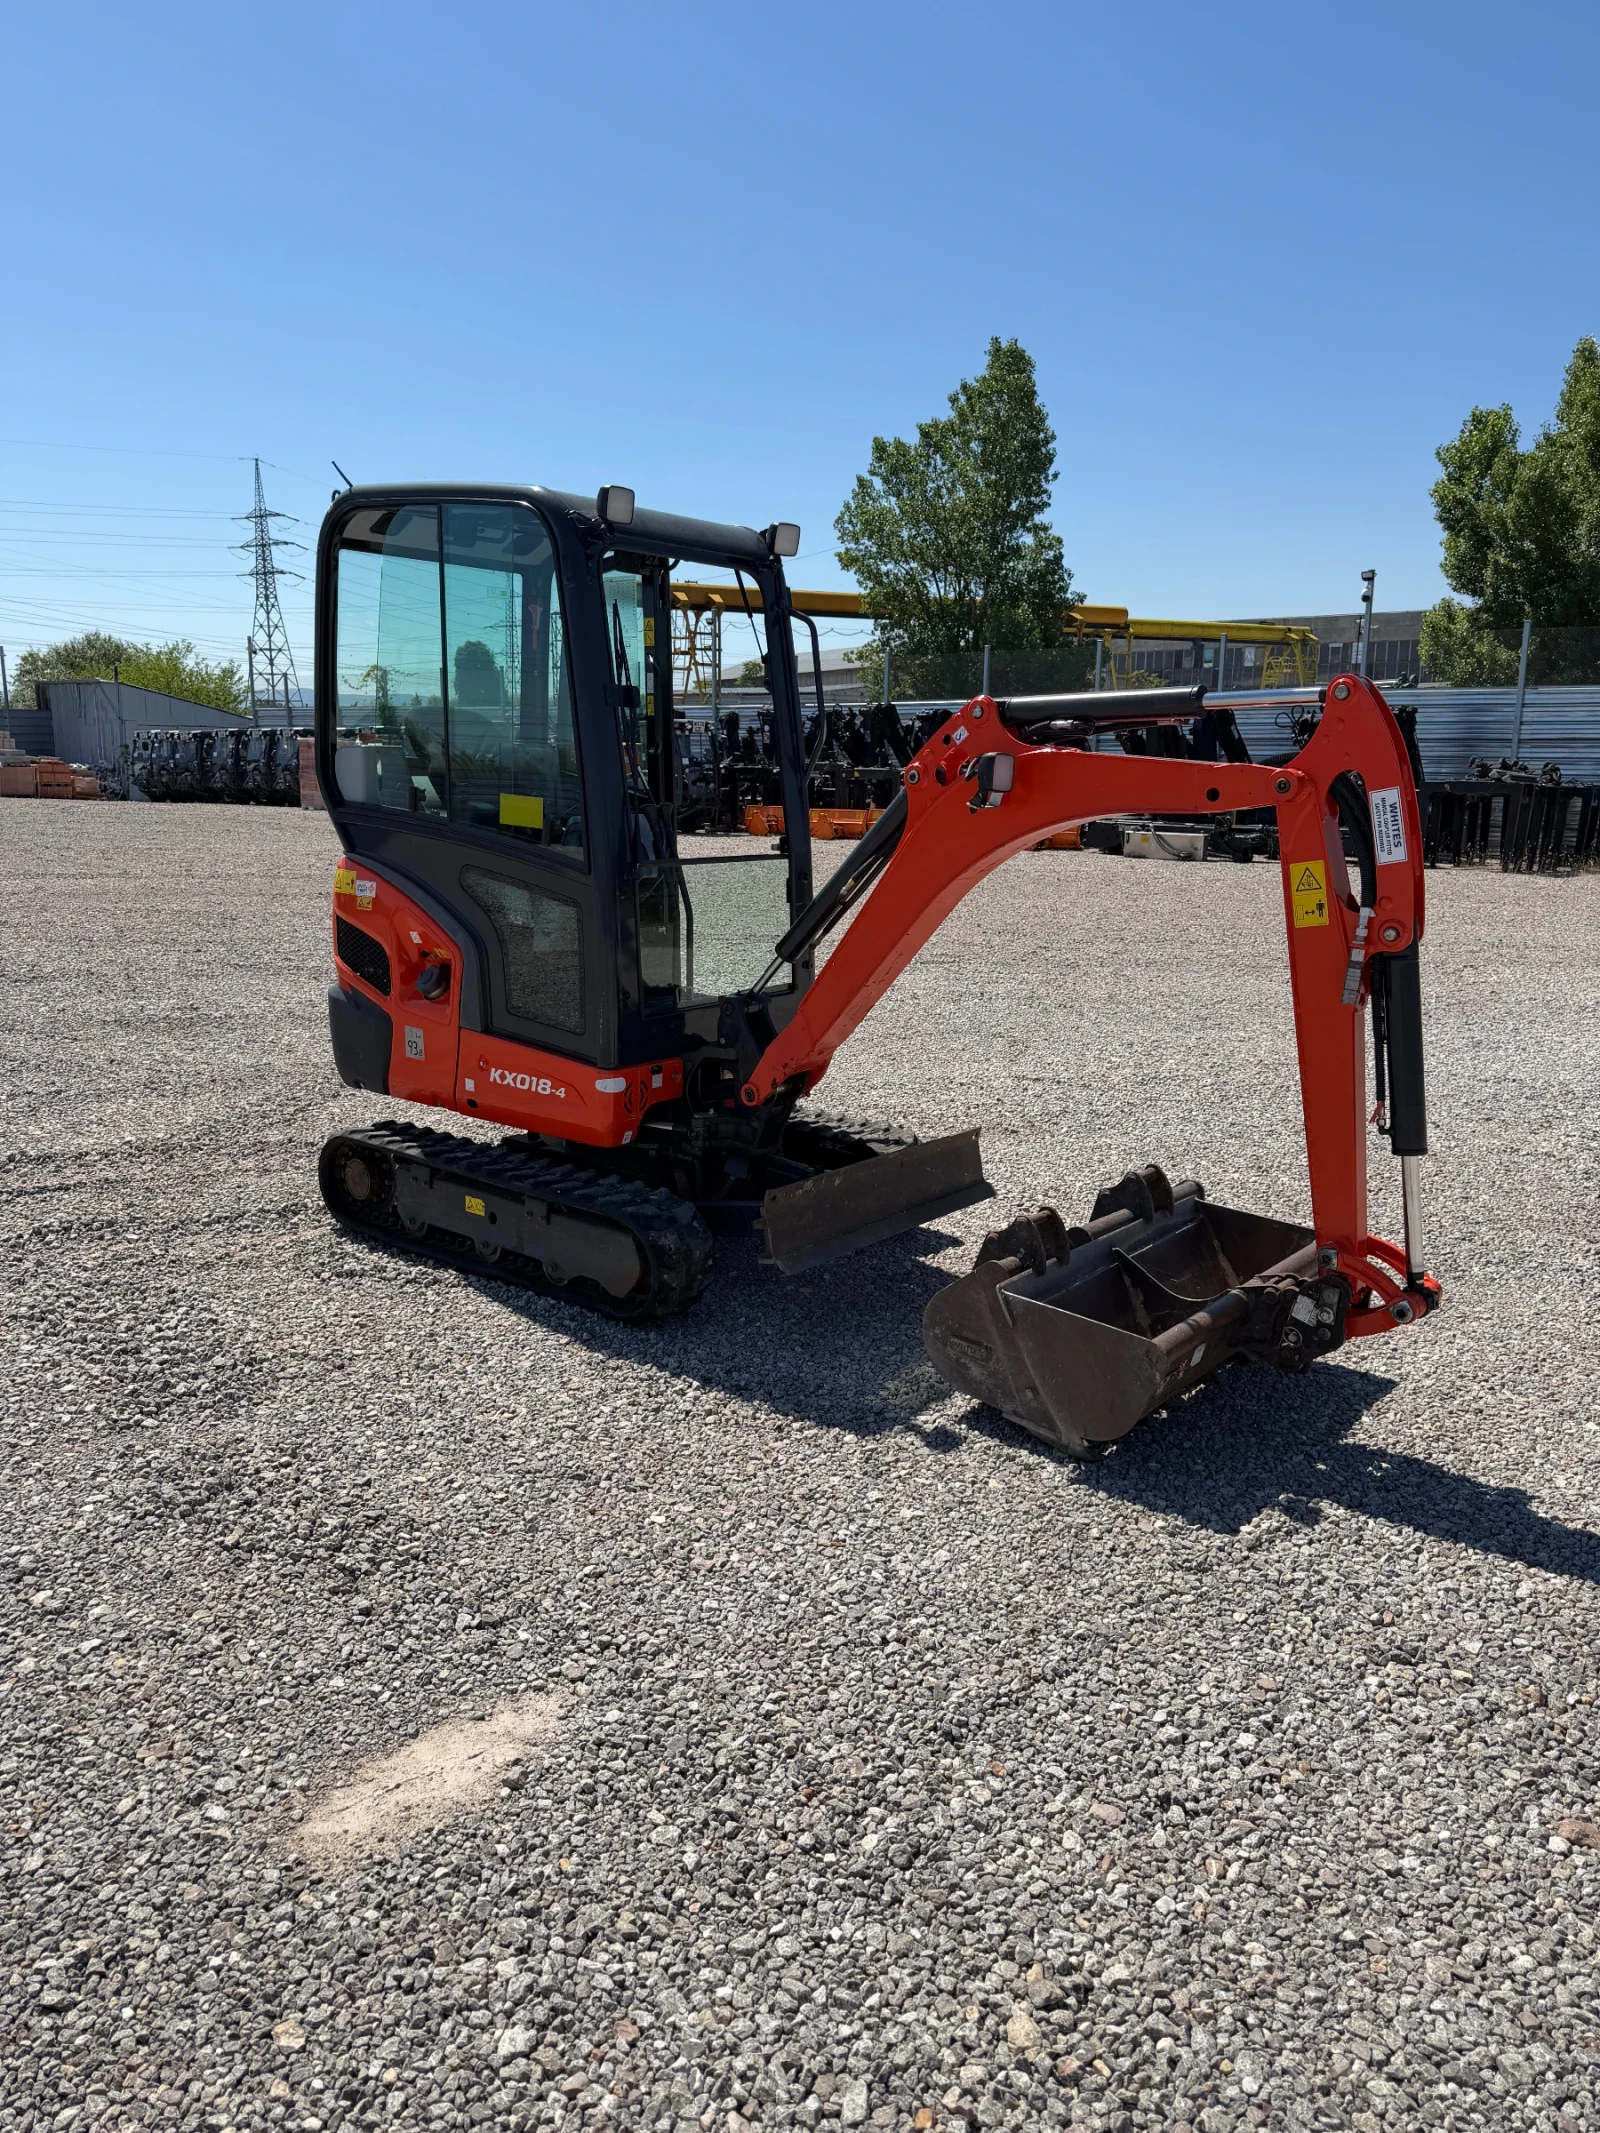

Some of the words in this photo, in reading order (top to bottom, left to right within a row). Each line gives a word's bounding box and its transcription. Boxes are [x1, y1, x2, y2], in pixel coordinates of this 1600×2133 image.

[1389, 802, 1402, 848] WHITES
[408, 1040, 418, 1056] 93
[489, 1067, 566, 1098] KX018-4
